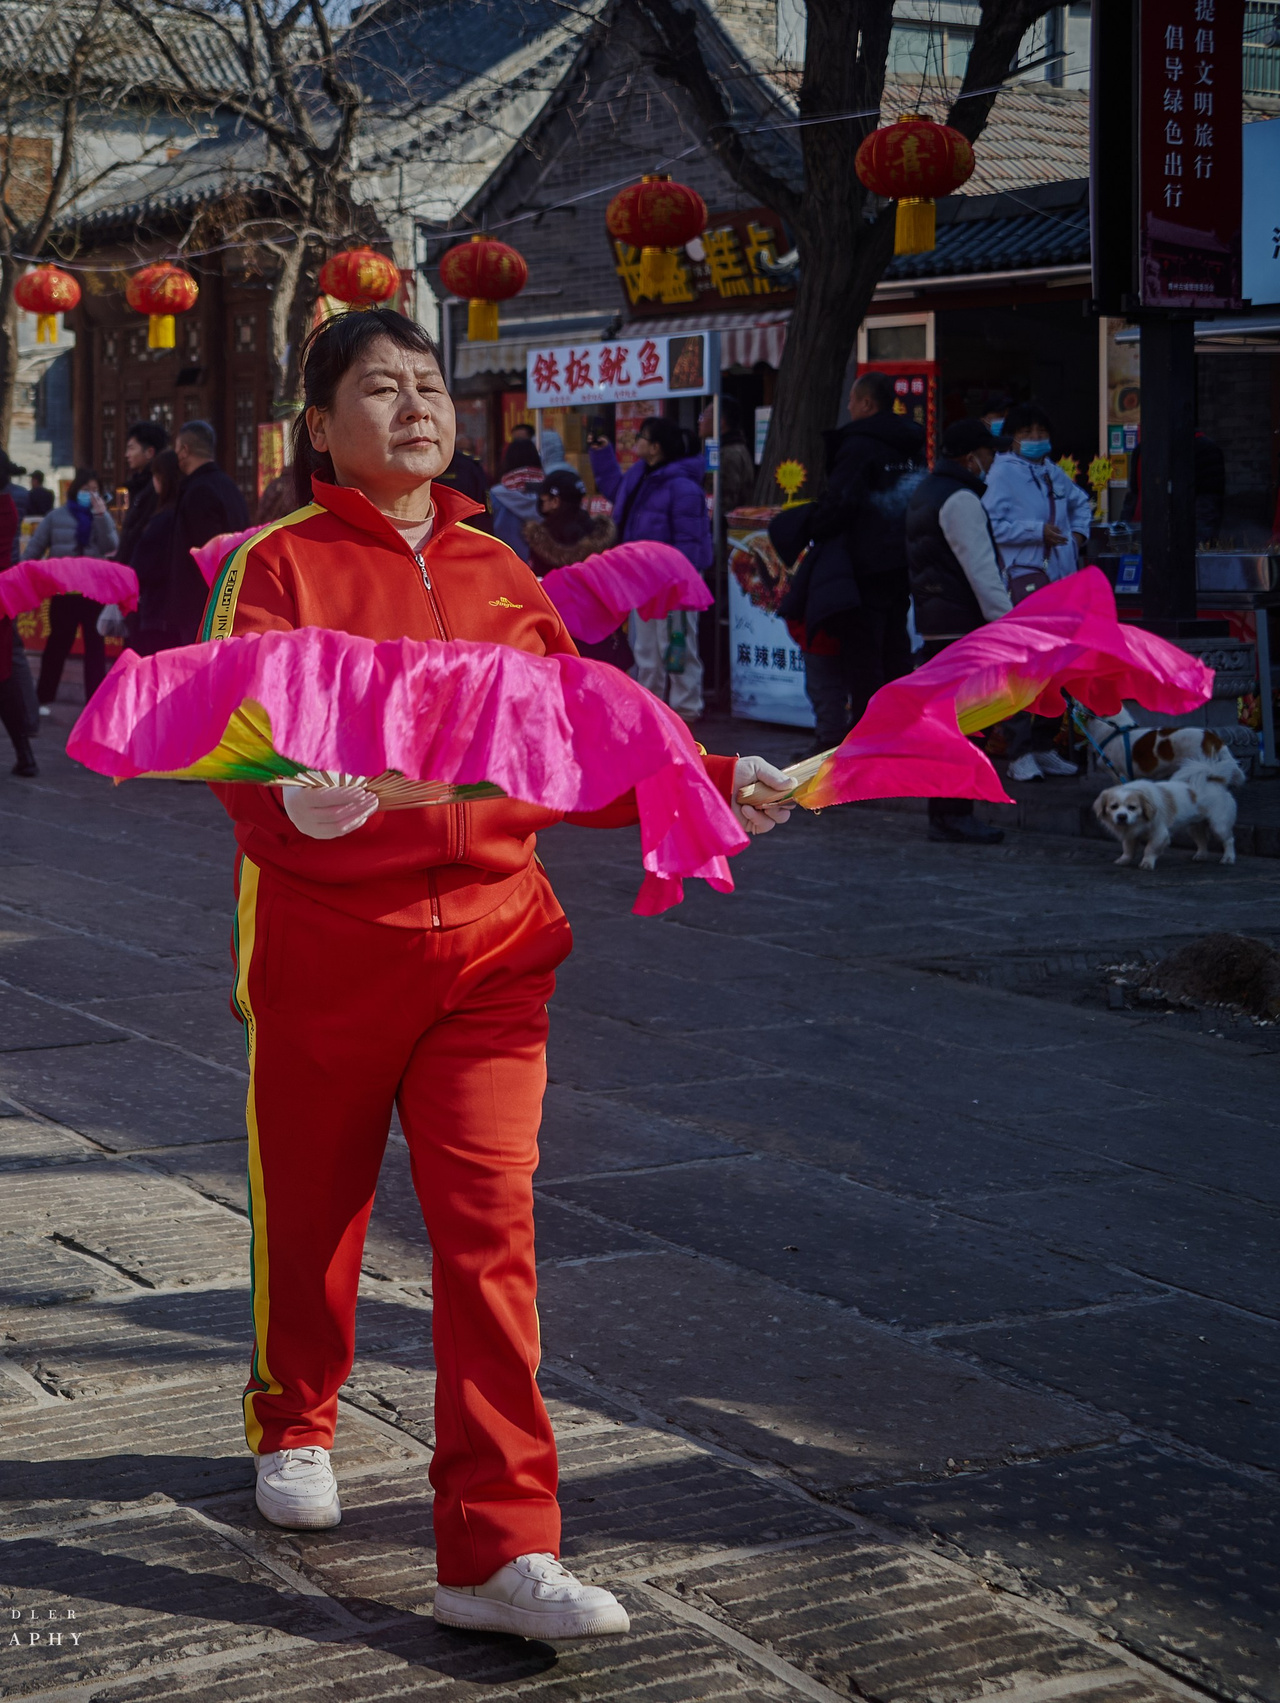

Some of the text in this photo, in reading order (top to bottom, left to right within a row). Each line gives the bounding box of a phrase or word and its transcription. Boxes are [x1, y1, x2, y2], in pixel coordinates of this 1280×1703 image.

[1163, 24, 1185, 208] 倡导绿色出行
[1193, 0, 1215, 179] 提倡文明旅行
[531, 339, 664, 395] 铁板鱿鱼
